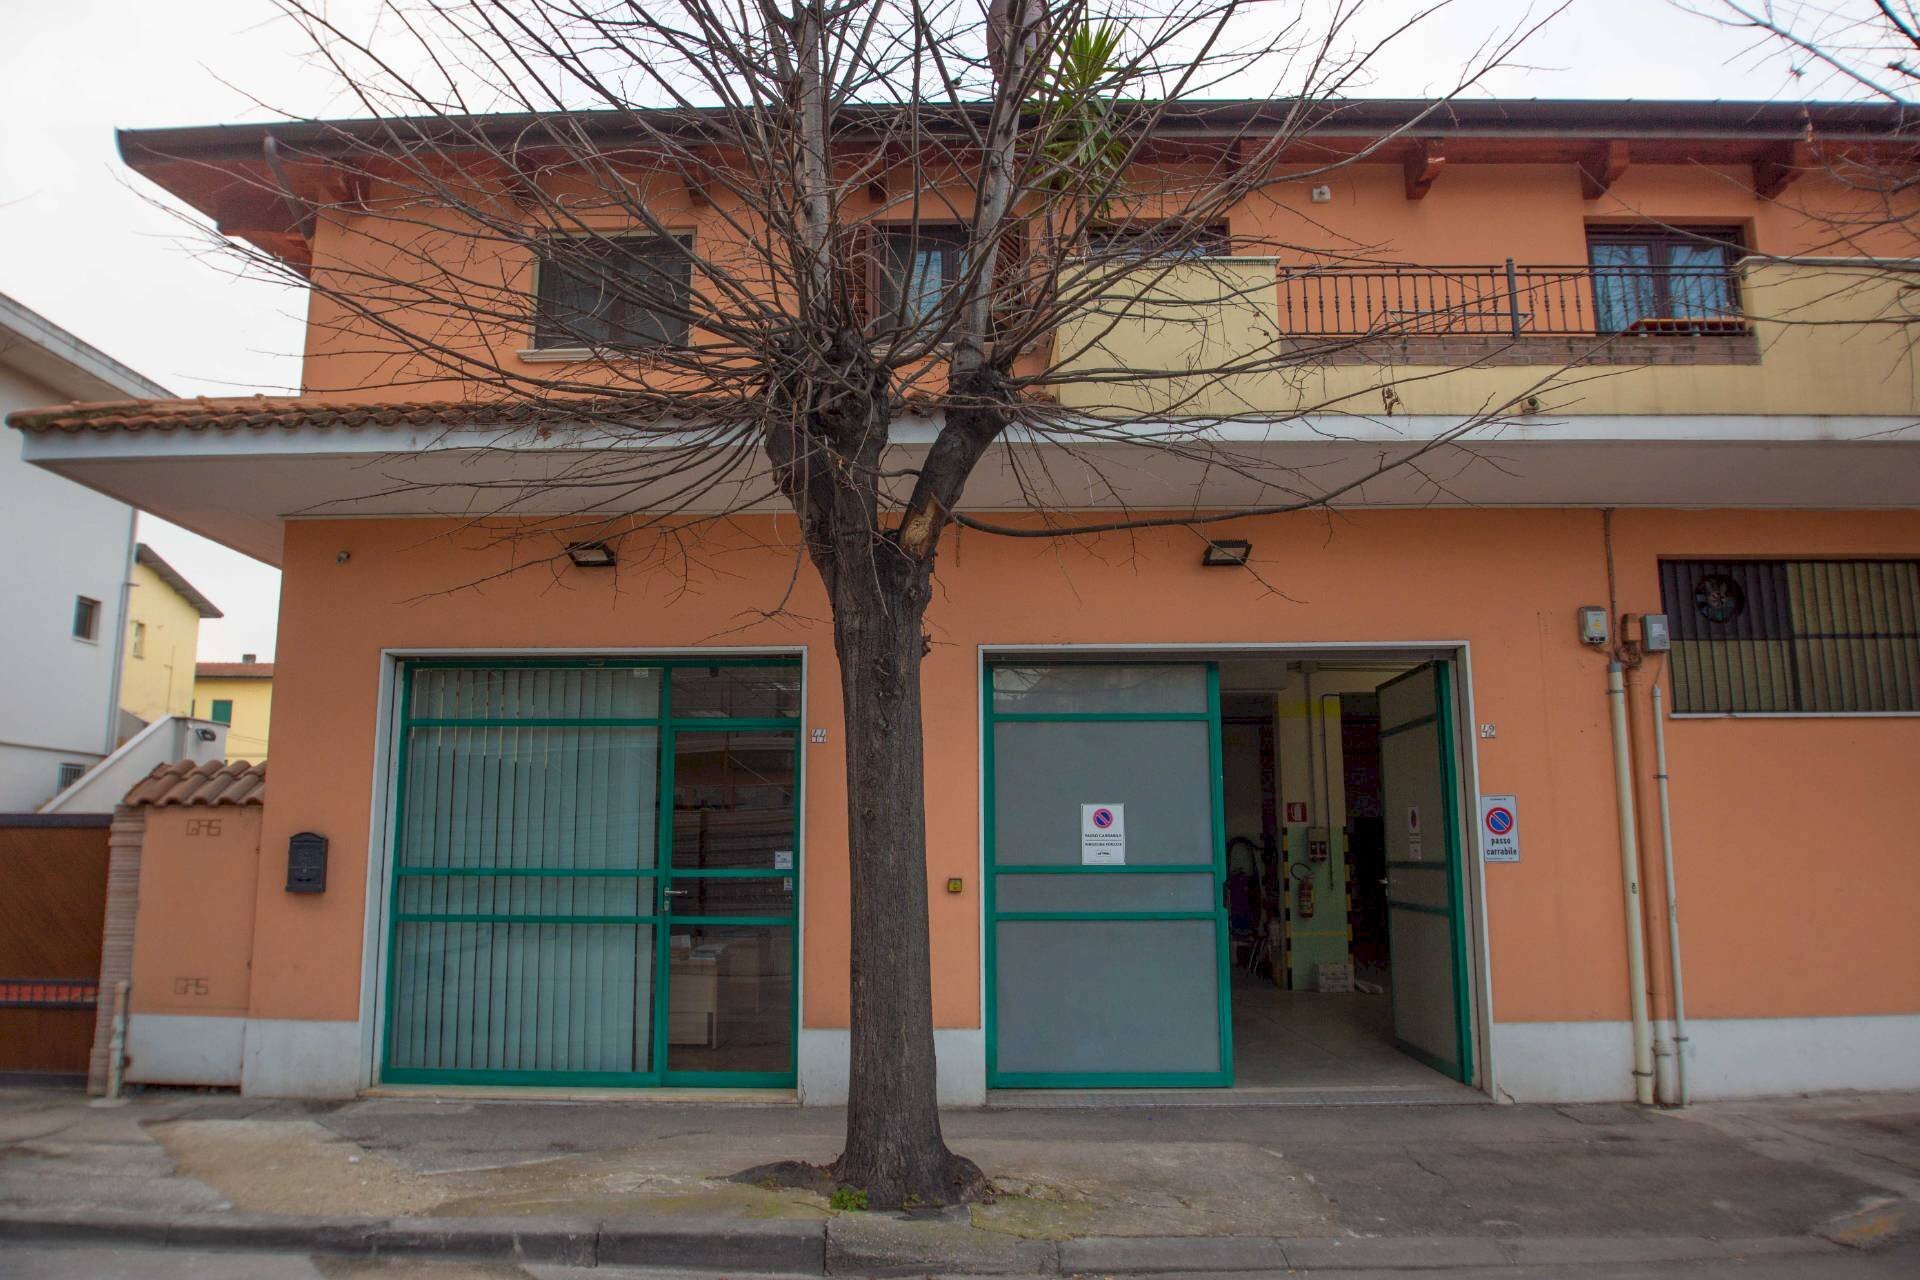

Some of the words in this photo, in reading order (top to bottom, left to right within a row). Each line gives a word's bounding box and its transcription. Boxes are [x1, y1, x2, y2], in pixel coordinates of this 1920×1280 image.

[1481, 724, 1495, 737] 42
[186, 819, 221, 837] GAS
[1491, 838, 1511, 846] passo
[1486, 847, 1517, 856] carrabile
[174, 977, 208, 996] GAS
